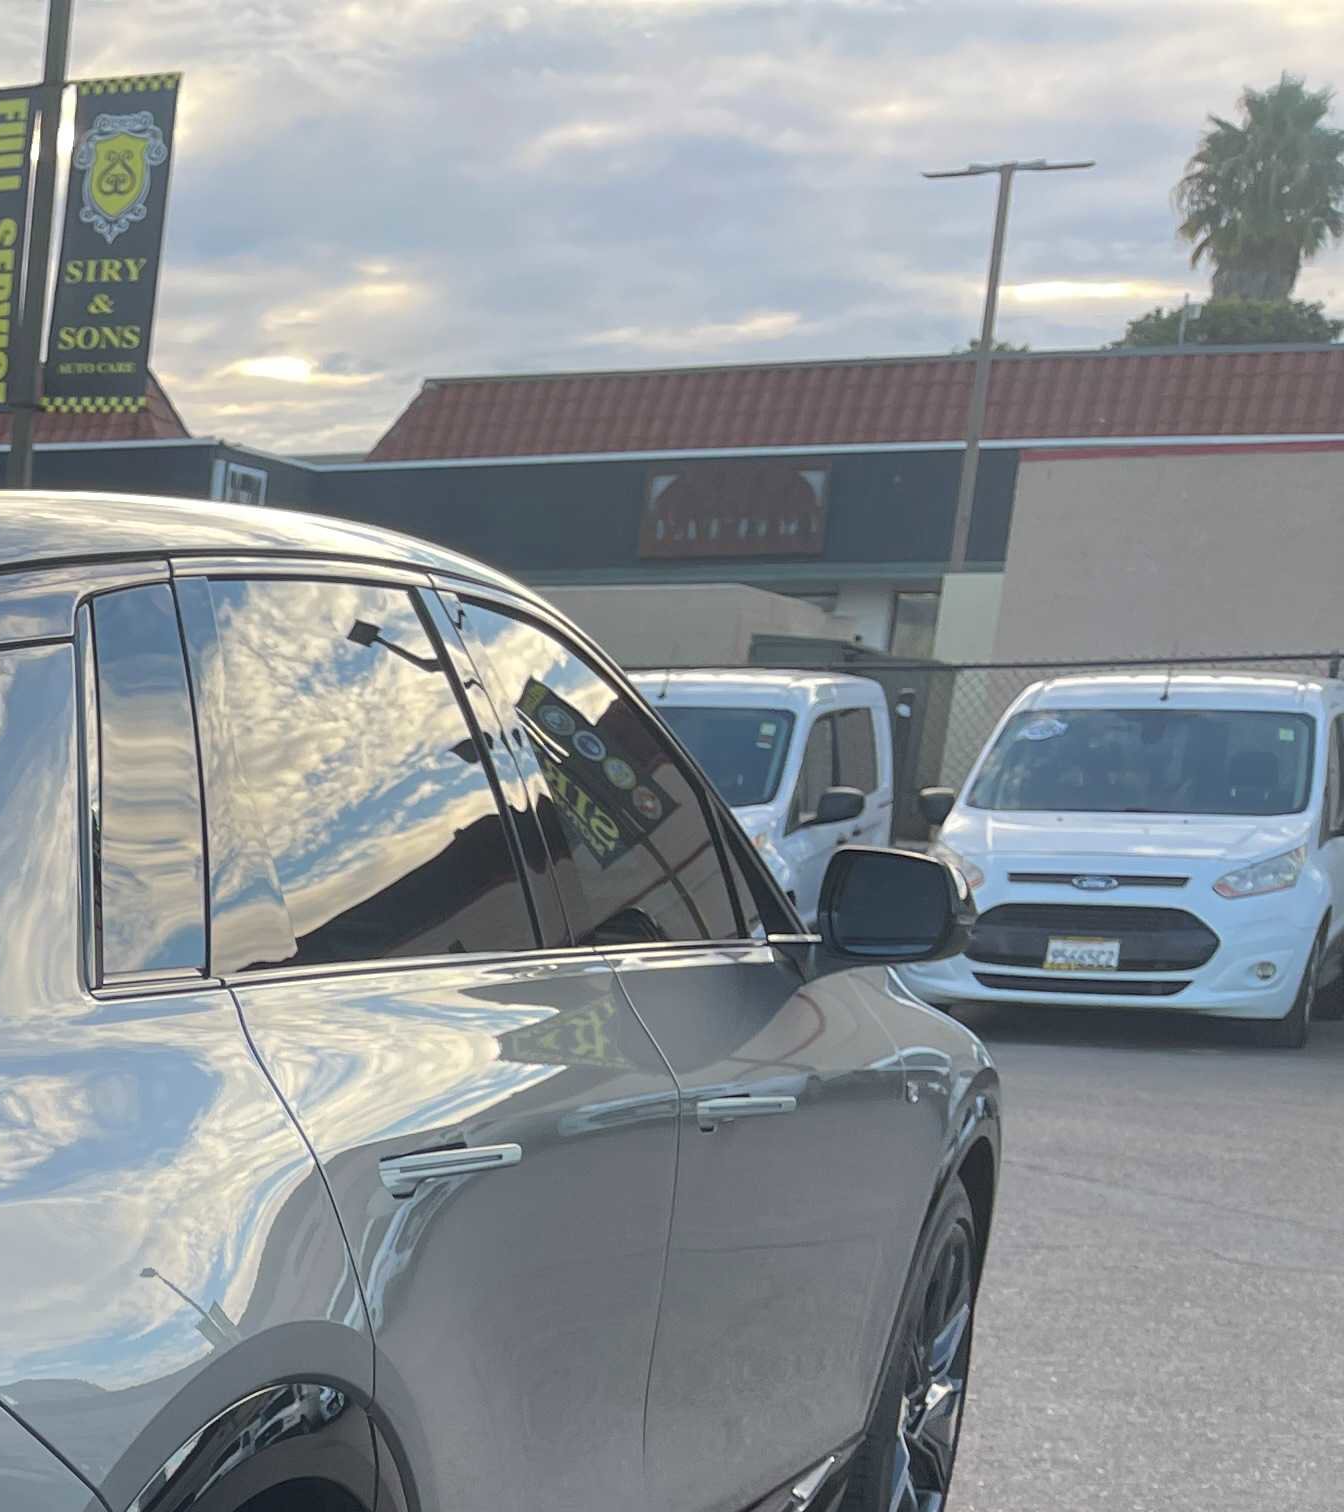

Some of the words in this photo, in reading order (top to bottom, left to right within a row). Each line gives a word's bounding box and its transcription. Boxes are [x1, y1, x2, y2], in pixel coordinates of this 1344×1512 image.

[64, 258, 147, 284] SIRY
[87, 294, 114, 315] &
[57, 325, 140, 351] SONS
